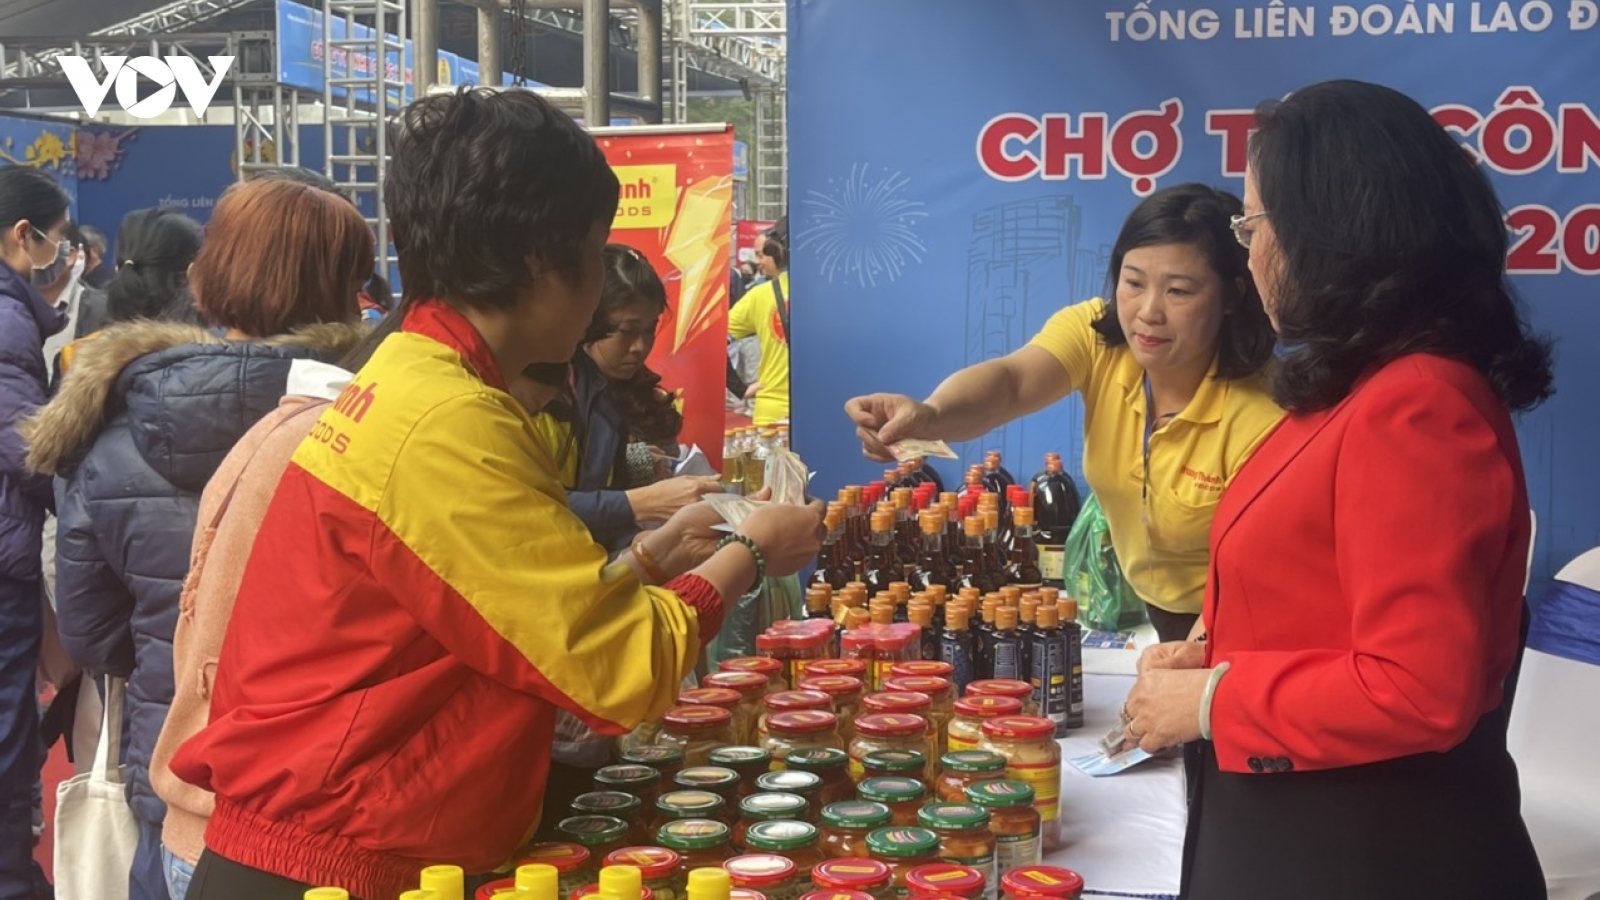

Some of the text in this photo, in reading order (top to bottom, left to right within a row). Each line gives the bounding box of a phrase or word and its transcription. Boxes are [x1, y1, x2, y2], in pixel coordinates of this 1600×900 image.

[1235, 0, 1315, 38] LIÊN
[1329, 0, 1454, 36] ĐOÀN
[1470, 0, 1553, 32] LAO
[977, 98, 1182, 196] CHỢ
